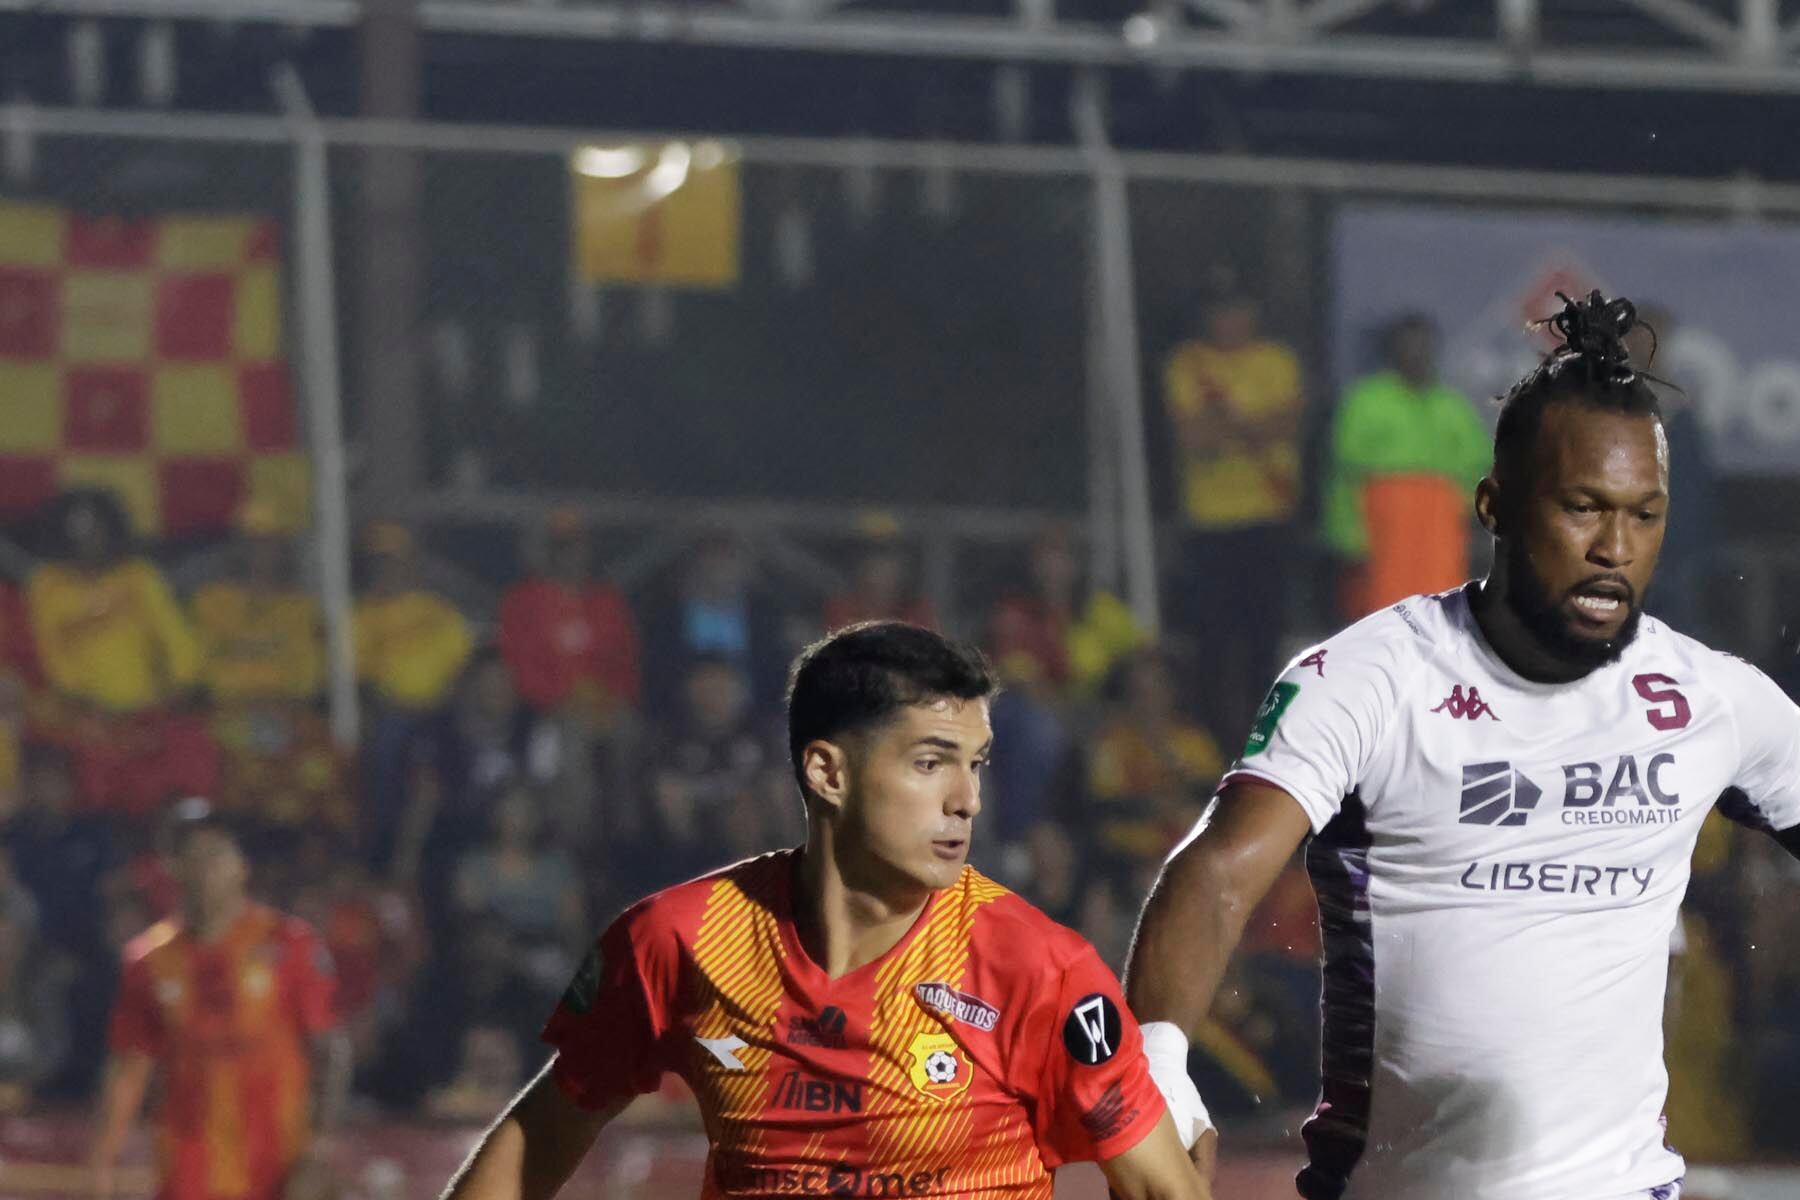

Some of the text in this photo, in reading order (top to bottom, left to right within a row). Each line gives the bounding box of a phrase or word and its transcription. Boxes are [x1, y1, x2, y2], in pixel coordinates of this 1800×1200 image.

[1632, 673, 1692, 731] S
[1561, 753, 1681, 807] BAC
[1460, 861, 1655, 897] LIBERTY
[918, 985, 997, 1030] TAQUERITOS
[804, 1080, 862, 1113] BN
